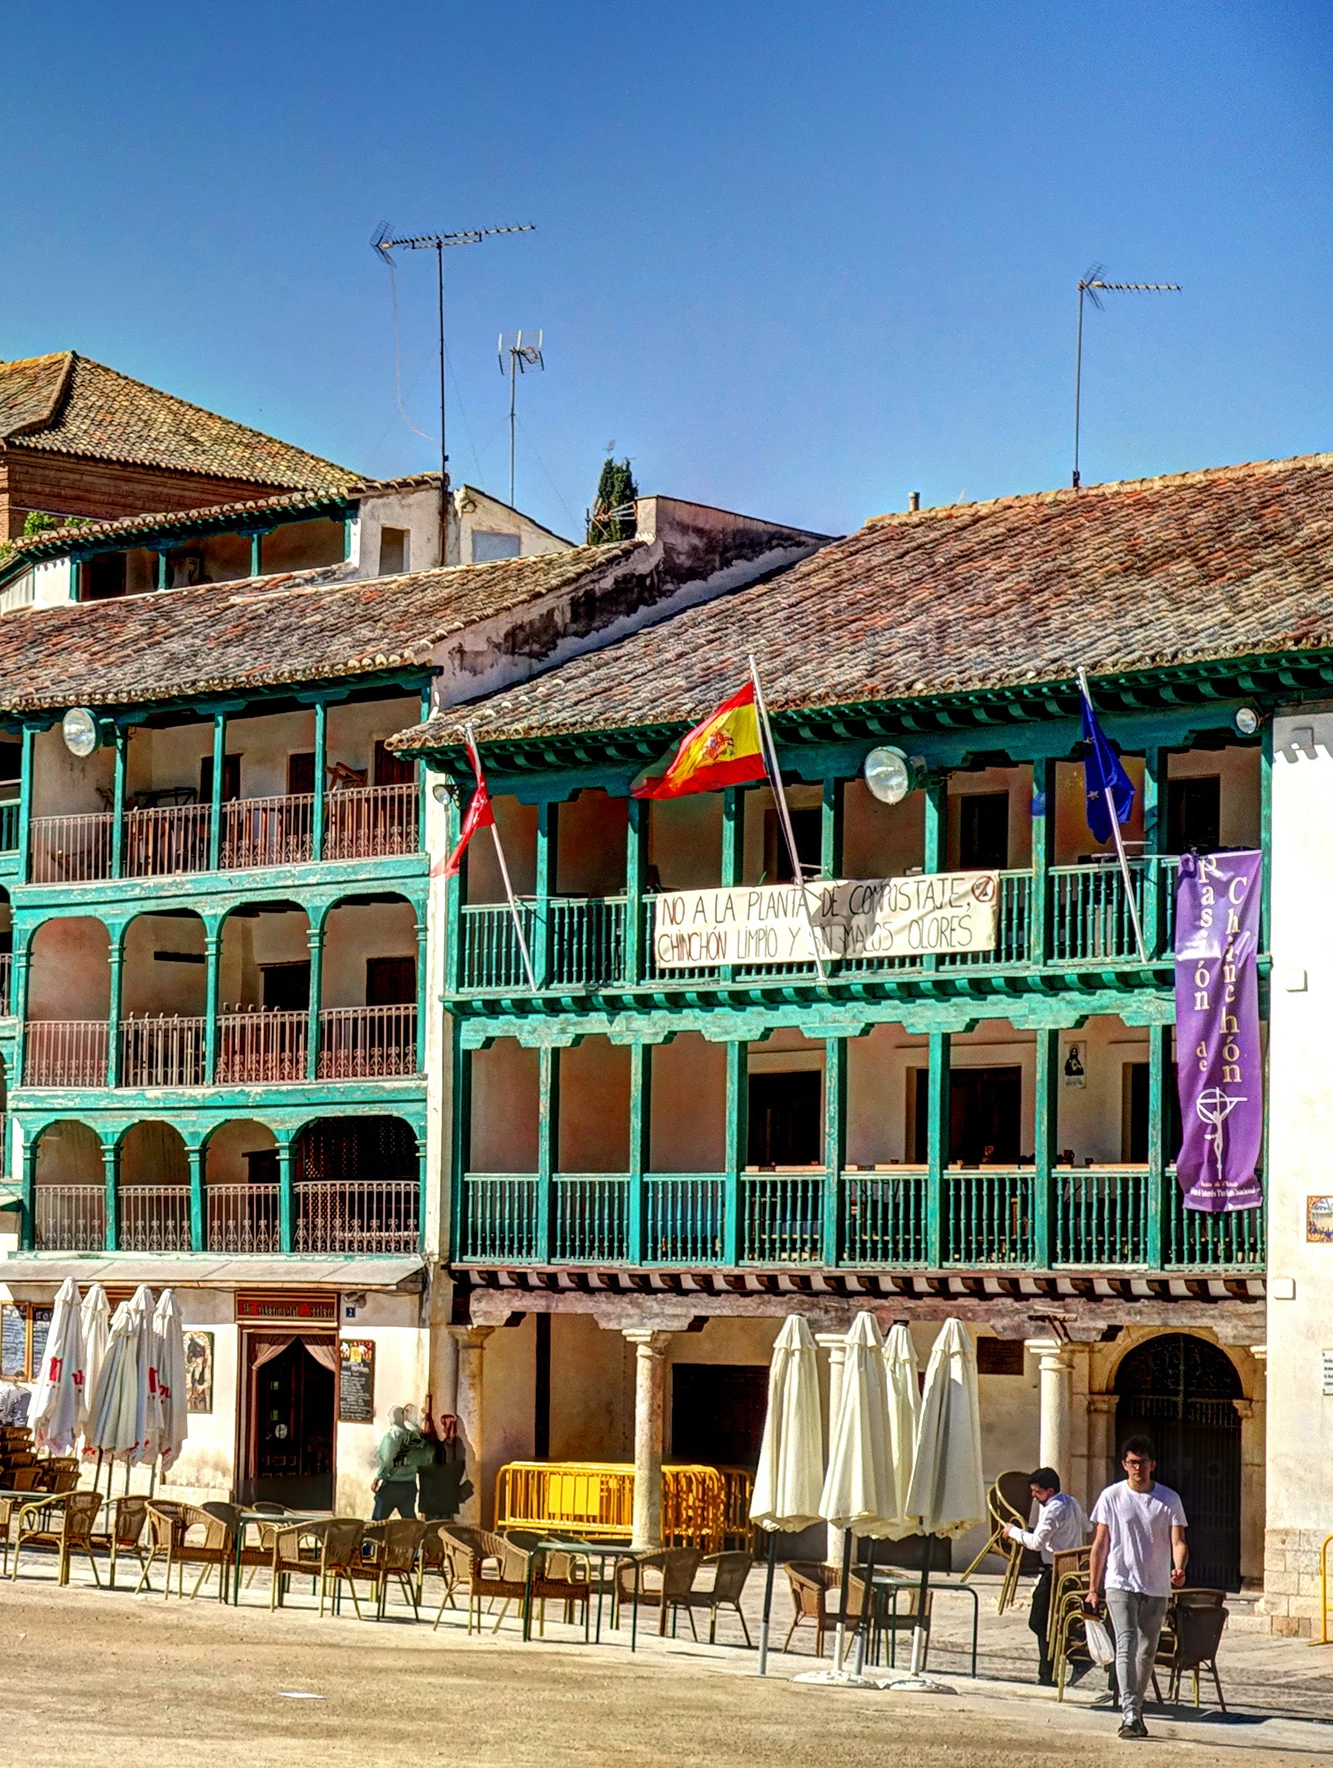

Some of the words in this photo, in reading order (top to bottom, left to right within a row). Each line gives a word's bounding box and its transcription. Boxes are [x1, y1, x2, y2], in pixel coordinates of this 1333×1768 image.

[662, 896, 686, 926] NO
[693, 894, 707, 924] A
[714, 893, 736, 923] LA
[747, 888, 809, 921] PLANTA
[822, 886, 842, 917] DE
[657, 926, 728, 962] CHINCHÓN
[788, 927, 802, 957] Y
[843, 922, 894, 952] MALOS
[908, 914, 973, 950] OLORES
[1220, 876, 1248, 1083] Chinchón
[1196, 1041, 1208, 1072] de
